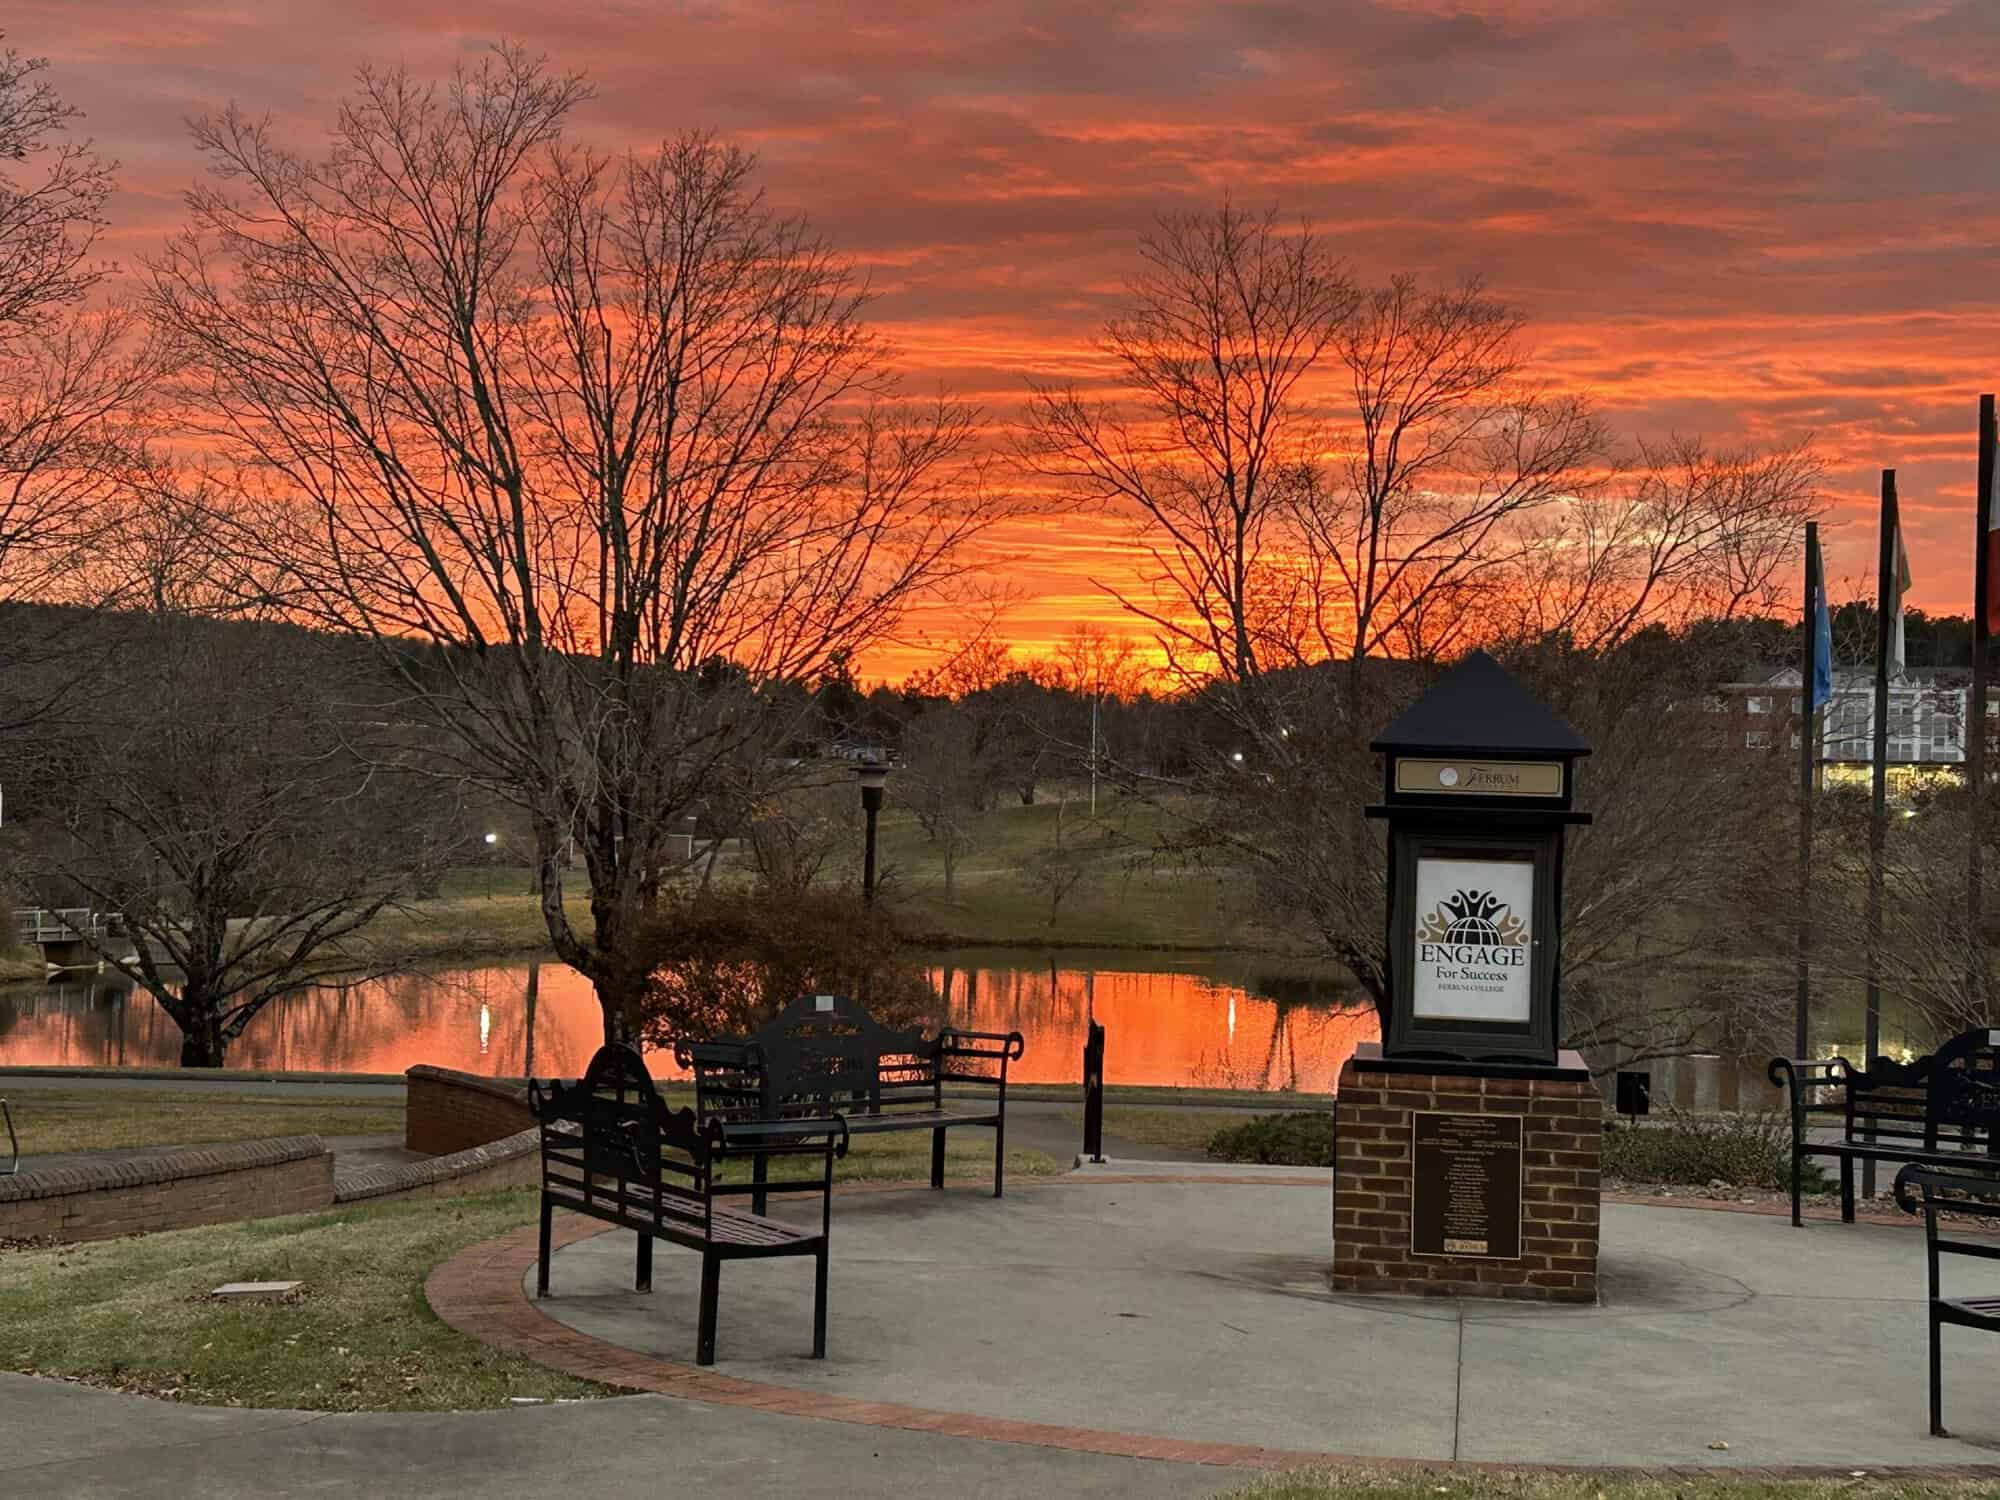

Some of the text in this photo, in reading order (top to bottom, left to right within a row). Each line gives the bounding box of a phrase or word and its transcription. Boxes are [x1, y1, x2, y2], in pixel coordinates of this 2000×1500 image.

[1464, 767, 1520, 787] FERRUM
[1420, 944, 1524, 966] ENGAGE
[1436, 966, 1508, 982] For Success
[1438, 983, 1505, 993] FERRUM COLLEGE
